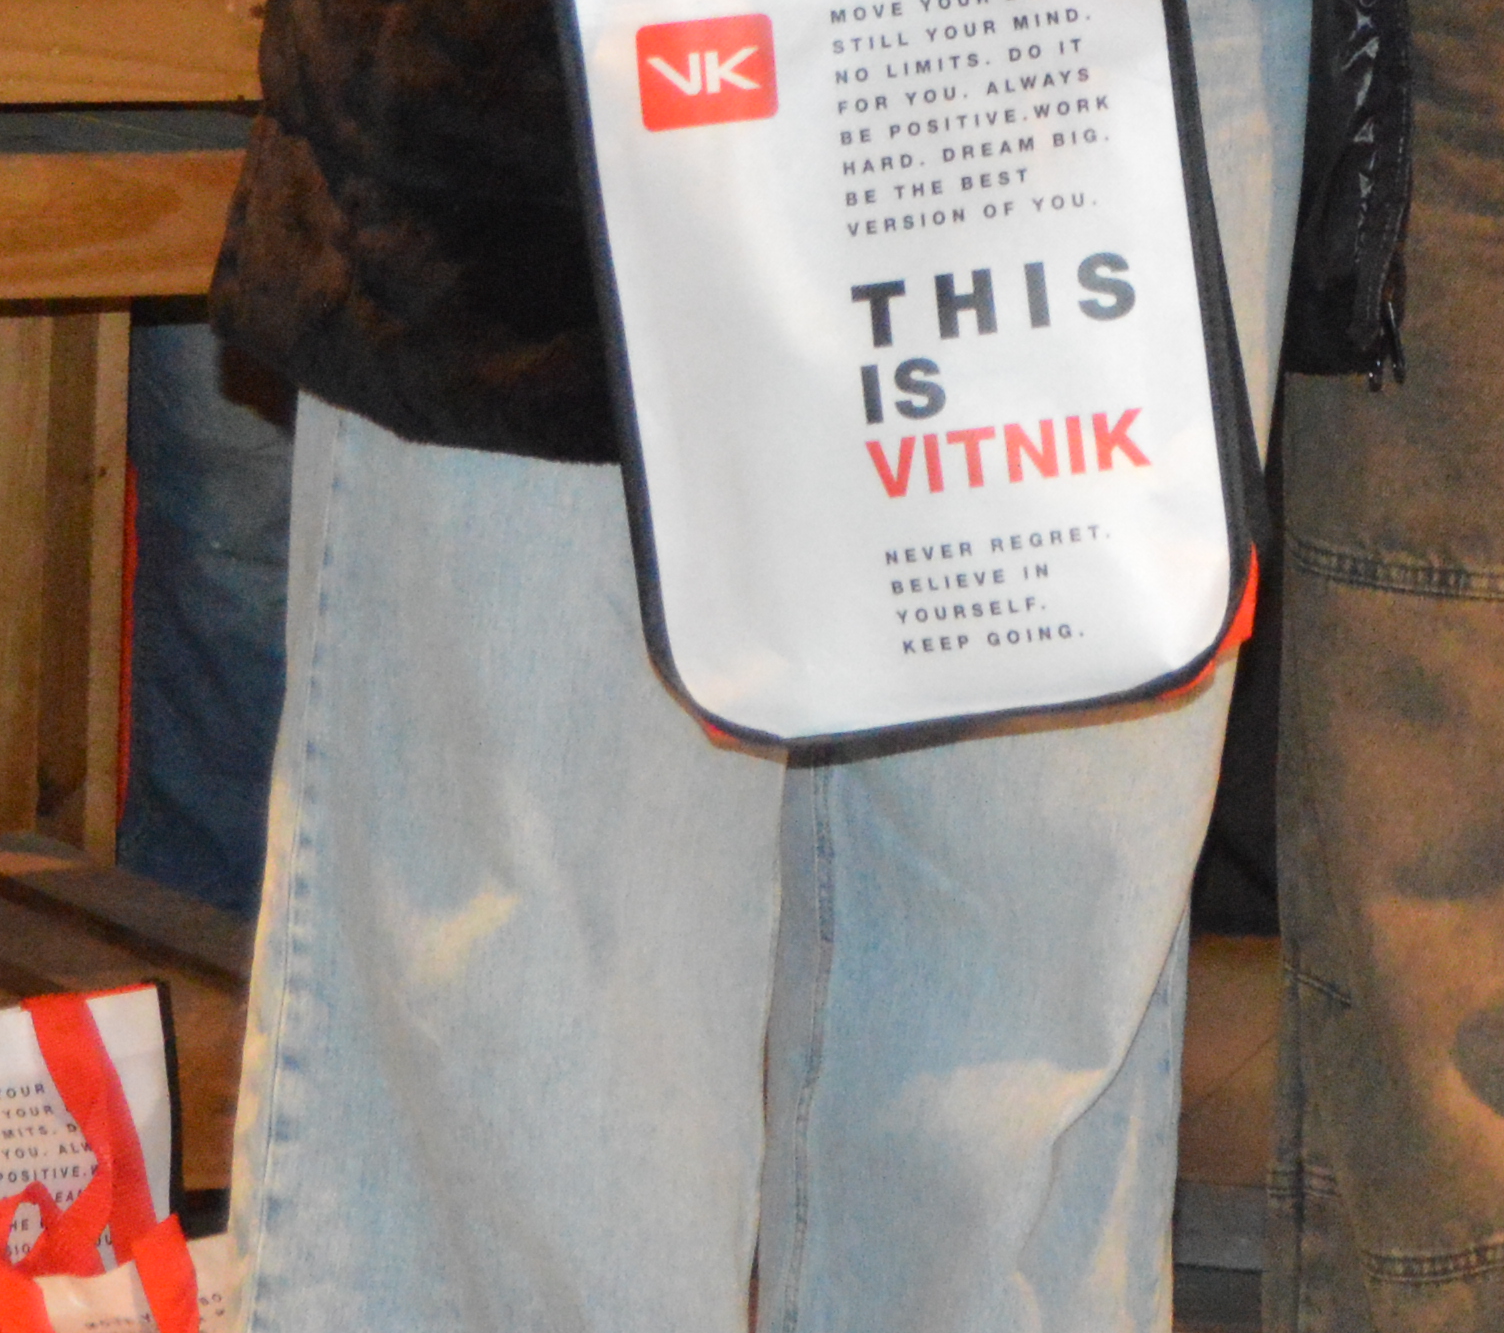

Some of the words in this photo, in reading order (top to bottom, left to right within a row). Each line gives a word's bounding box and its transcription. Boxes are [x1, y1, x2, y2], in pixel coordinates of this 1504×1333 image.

[829, 1, 903, 24] MOVE
[832, 31, 910, 55] STILL
[925, 19, 996, 42] YOUR
[1013, 6, 1093, 32] MIND.
[834, 66, 870, 85] NO
[886, 52, 990, 79] LIMITS.
[1007, 44, 1042, 63] DO
[1058, 37, 1082, 56] IT
[837, 94, 888, 115] FOR
[904, 85, 967, 106] YOU.
[986, 67, 1090, 96] ALWAYS
[839, 127, 872, 146] BE
[842, 152, 925, 176] HARD.
[941, 136, 1035, 163] DREAM
[1052, 126, 1112, 151] BIG.
[845, 188, 876, 207] BE
[893, 179, 943, 200] THE
[960, 167, 1027, 192] BEST
[847, 208, 966, 237] VERSION
[982, 200, 1014, 220] OF
[1031, 191, 1099, 215] YOU.
[850, 252, 1135, 349] THIS
[860, 357, 946, 425] IS
[864, 408, 1150, 500] VITNIK
[884, 541, 972, 566] NEVER
[990, 523, 1113, 553] REGRET.
[890, 568, 1004, 596] BELIEVE
[1022, 563, 1049, 580] IN
[895, 595, 1049, 625] YOURSELF.
[902, 634, 969, 655] KEEP
[986, 623, 1084, 648] GOING.
